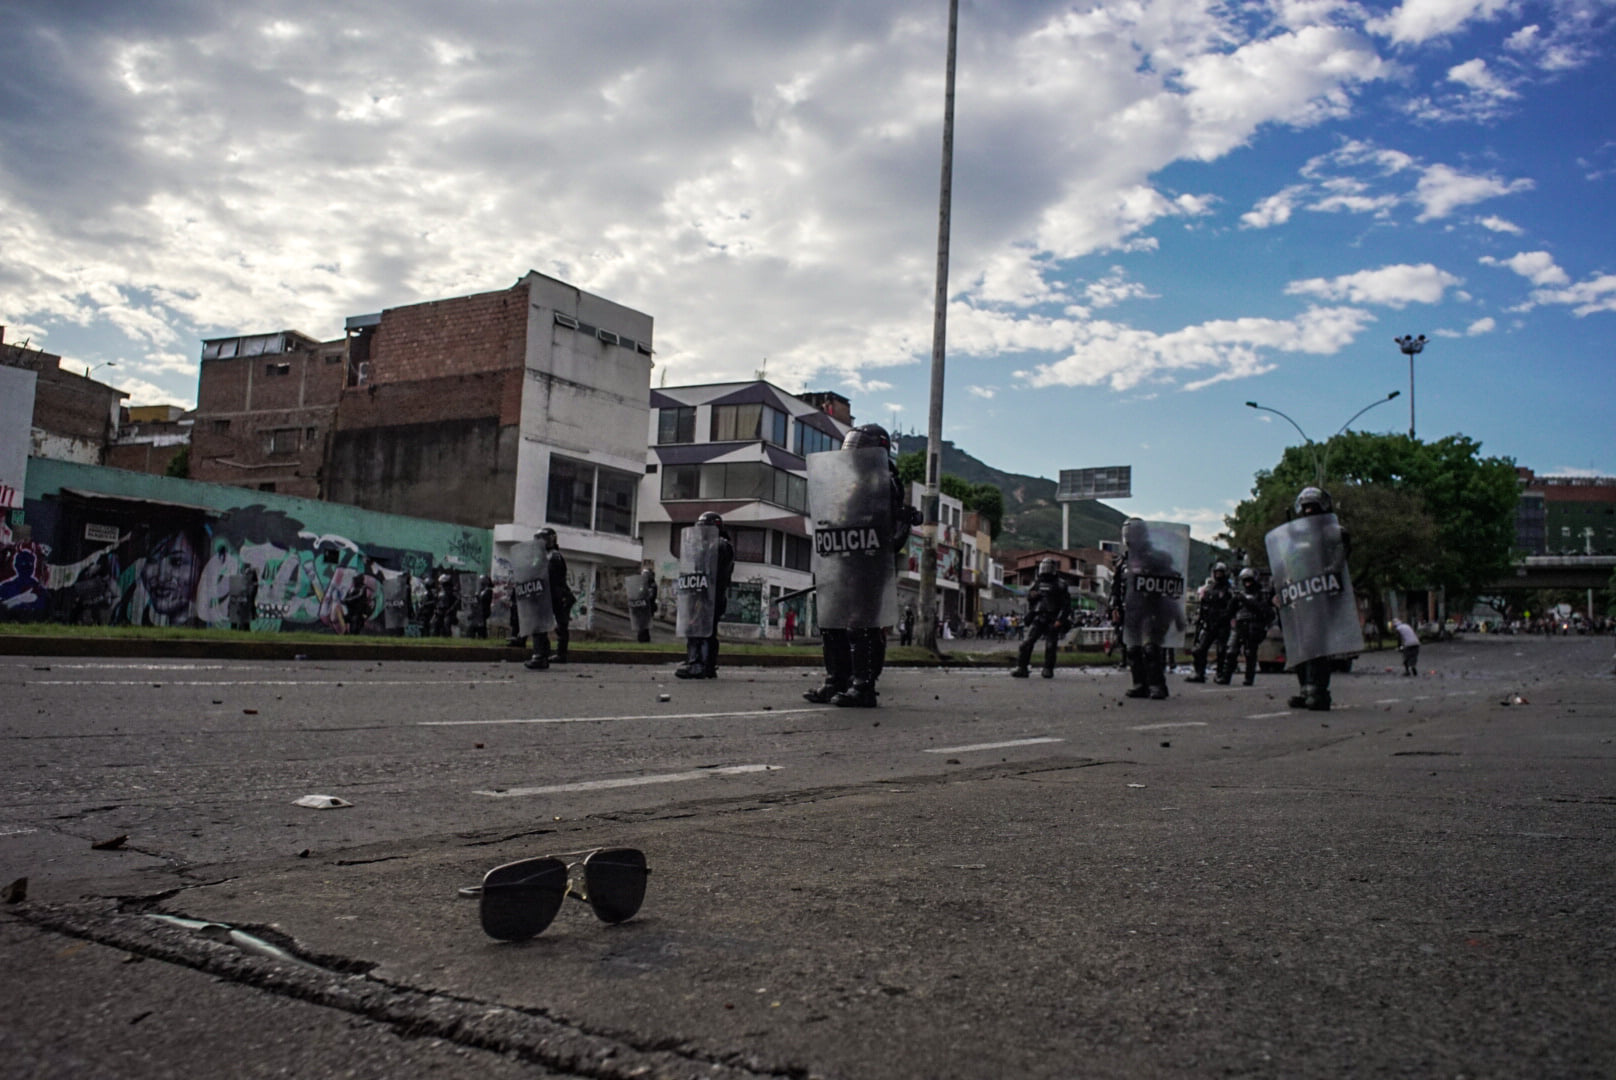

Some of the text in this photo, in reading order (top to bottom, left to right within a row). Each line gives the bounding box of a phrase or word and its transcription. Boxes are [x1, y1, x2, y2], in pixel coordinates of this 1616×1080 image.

[816, 529, 880, 552] POLICIA
[1136, 576, 1183, 593] POLICIA
[1281, 574, 1340, 604] POLICIA
